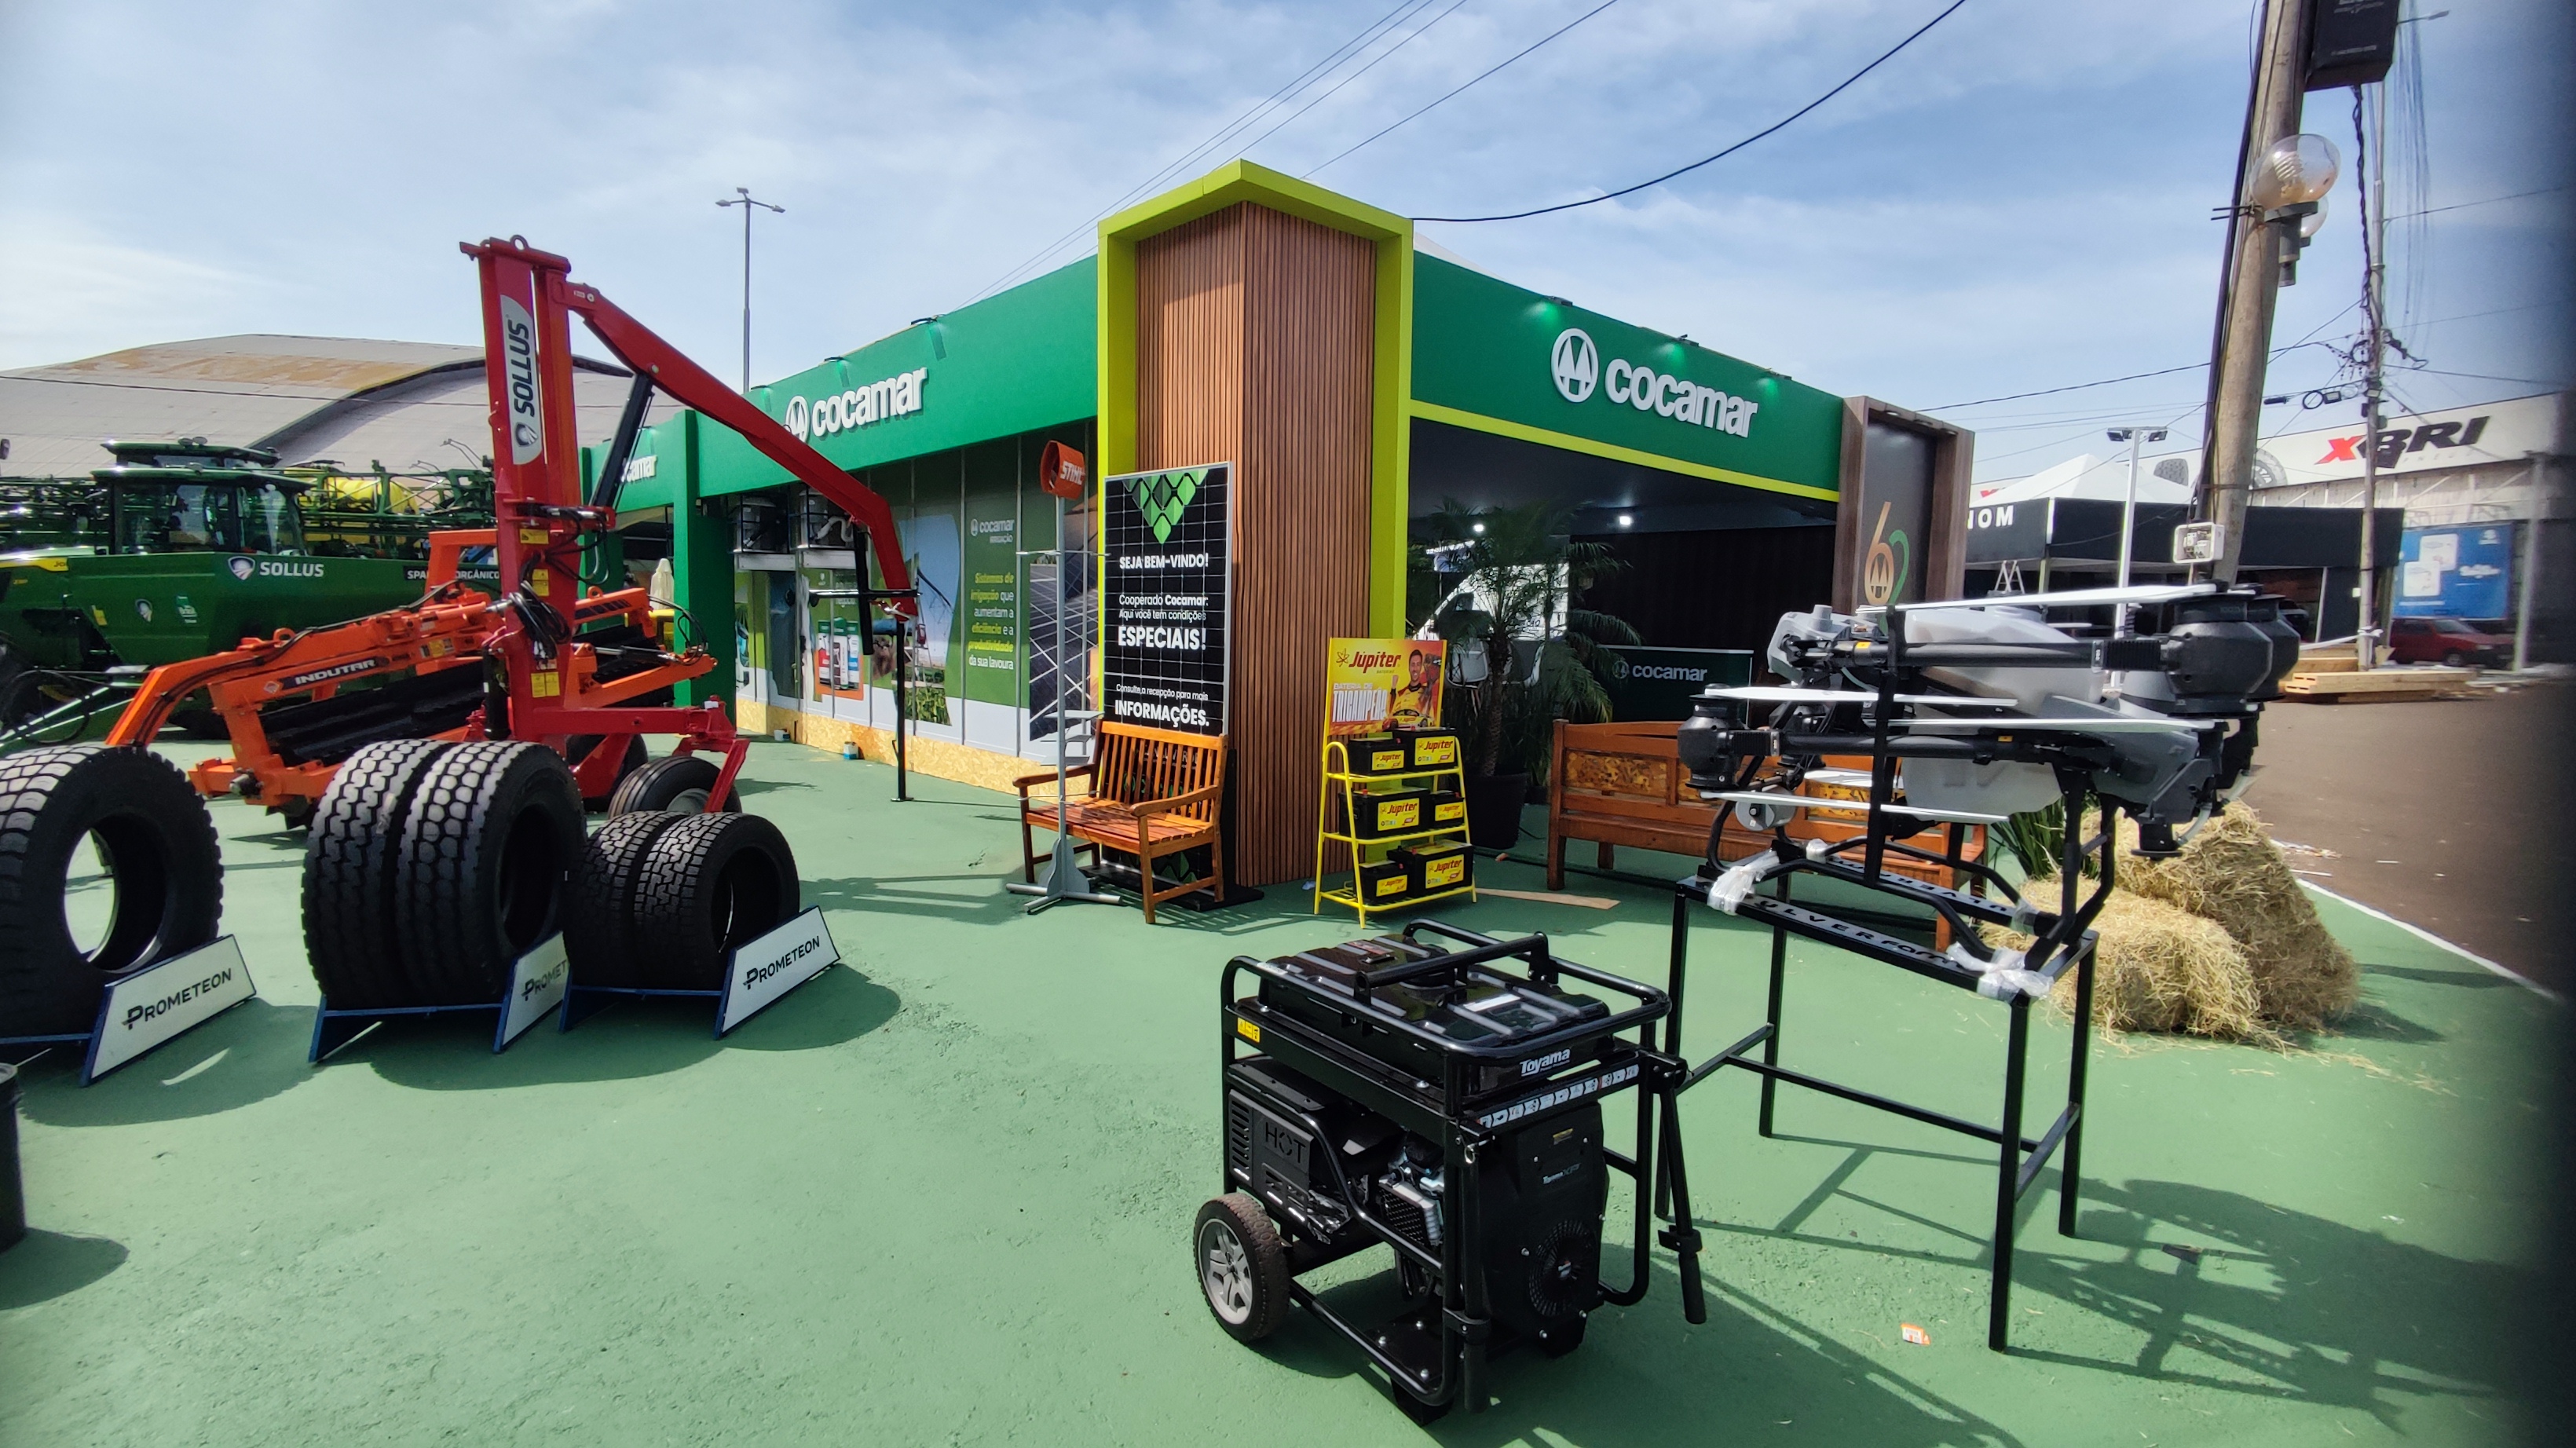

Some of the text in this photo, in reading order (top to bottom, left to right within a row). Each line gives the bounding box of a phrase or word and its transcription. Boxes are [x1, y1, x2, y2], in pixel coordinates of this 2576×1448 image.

[507, 319, 536, 418] SOLLUS
[812, 367, 928, 437] cocamar
[1605, 357, 1758, 438] cocamar
[1060, 460, 1084, 485] STIHL
[979, 519, 1015, 533] cocamar
[259, 561, 324, 577] SOLLUS
[1119, 553, 1209, 569] SEJA BEM-VINDO!
[1000, 591, 1014, 603] que
[1118, 594, 1209, 609] Cooperado Cocamar:
[1008, 609, 1014, 618] a
[1118, 609, 1207, 623] Aqui você tem condições
[1002, 626, 1008, 635] e
[1008, 626, 1014, 635] a
[1118, 626, 1206, 650] ESPECIAIS!
[295, 659, 375, 685] INDUTAR
[968, 654, 1014, 670] da sua lavoura
[1632, 665, 1708, 682] cocamar
[1116, 683, 1141, 693] Consulte
[1147, 688, 1176, 699] recepção
[1176, 690, 1191, 700] para
[1191, 692, 1209, 701] mais
[1114, 700, 1210, 728] INFORMAÇÕES.
[743, 935, 820, 990] PROMETEON
[521, 959, 568, 1002] PROMET
[122, 967, 232, 1030] PROMETEON
[1520, 1048, 1571, 1077] Toyama
[1265, 1121, 1306, 1164] HOT
